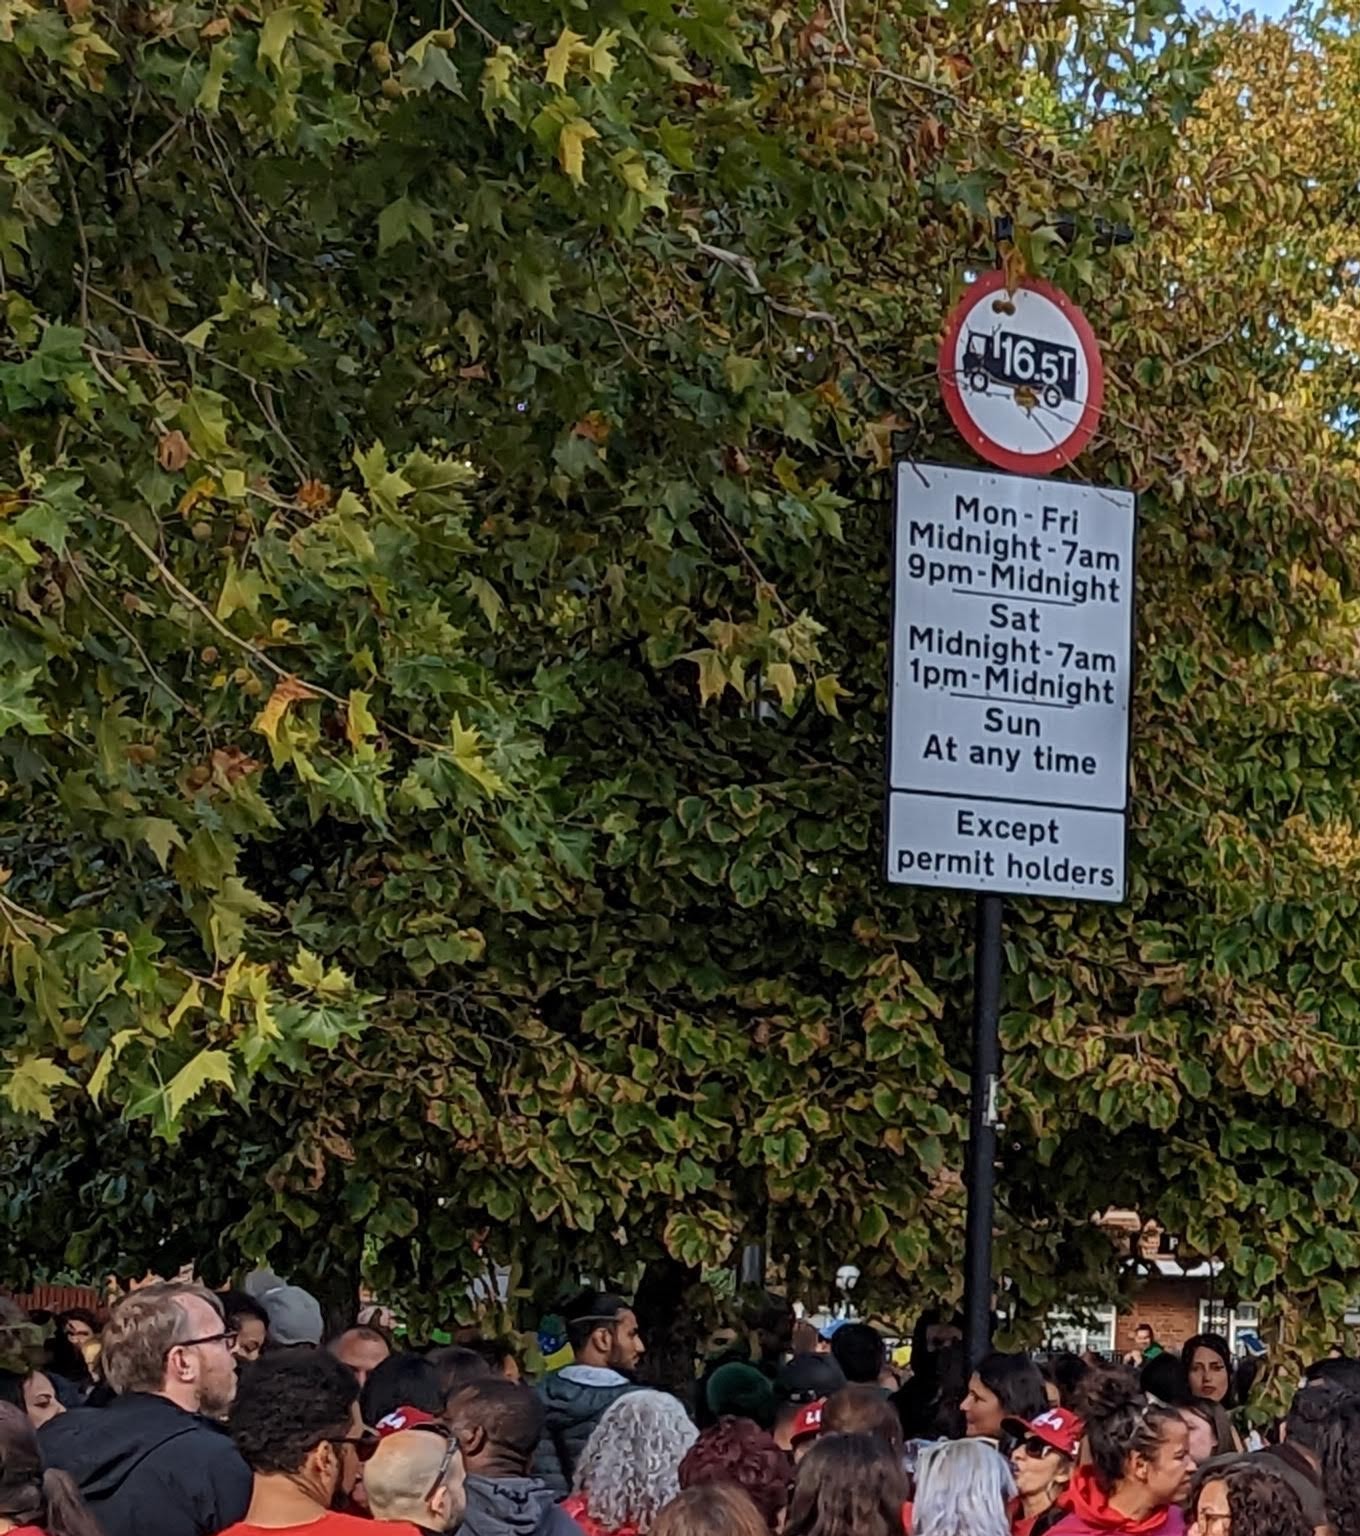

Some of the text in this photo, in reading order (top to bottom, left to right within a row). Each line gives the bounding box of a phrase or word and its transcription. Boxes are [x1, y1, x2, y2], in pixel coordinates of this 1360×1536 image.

[955, 495, 1017, 527] Mon
[1041, 505, 1079, 535] Fri
[989, 603, 1041, 633] Sat
[983, 707, 1041, 738] Sun
[923, 733, 1097, 775] At any time
[957, 809, 1059, 847] Except
[897, 849, 1115, 887] permit holders
